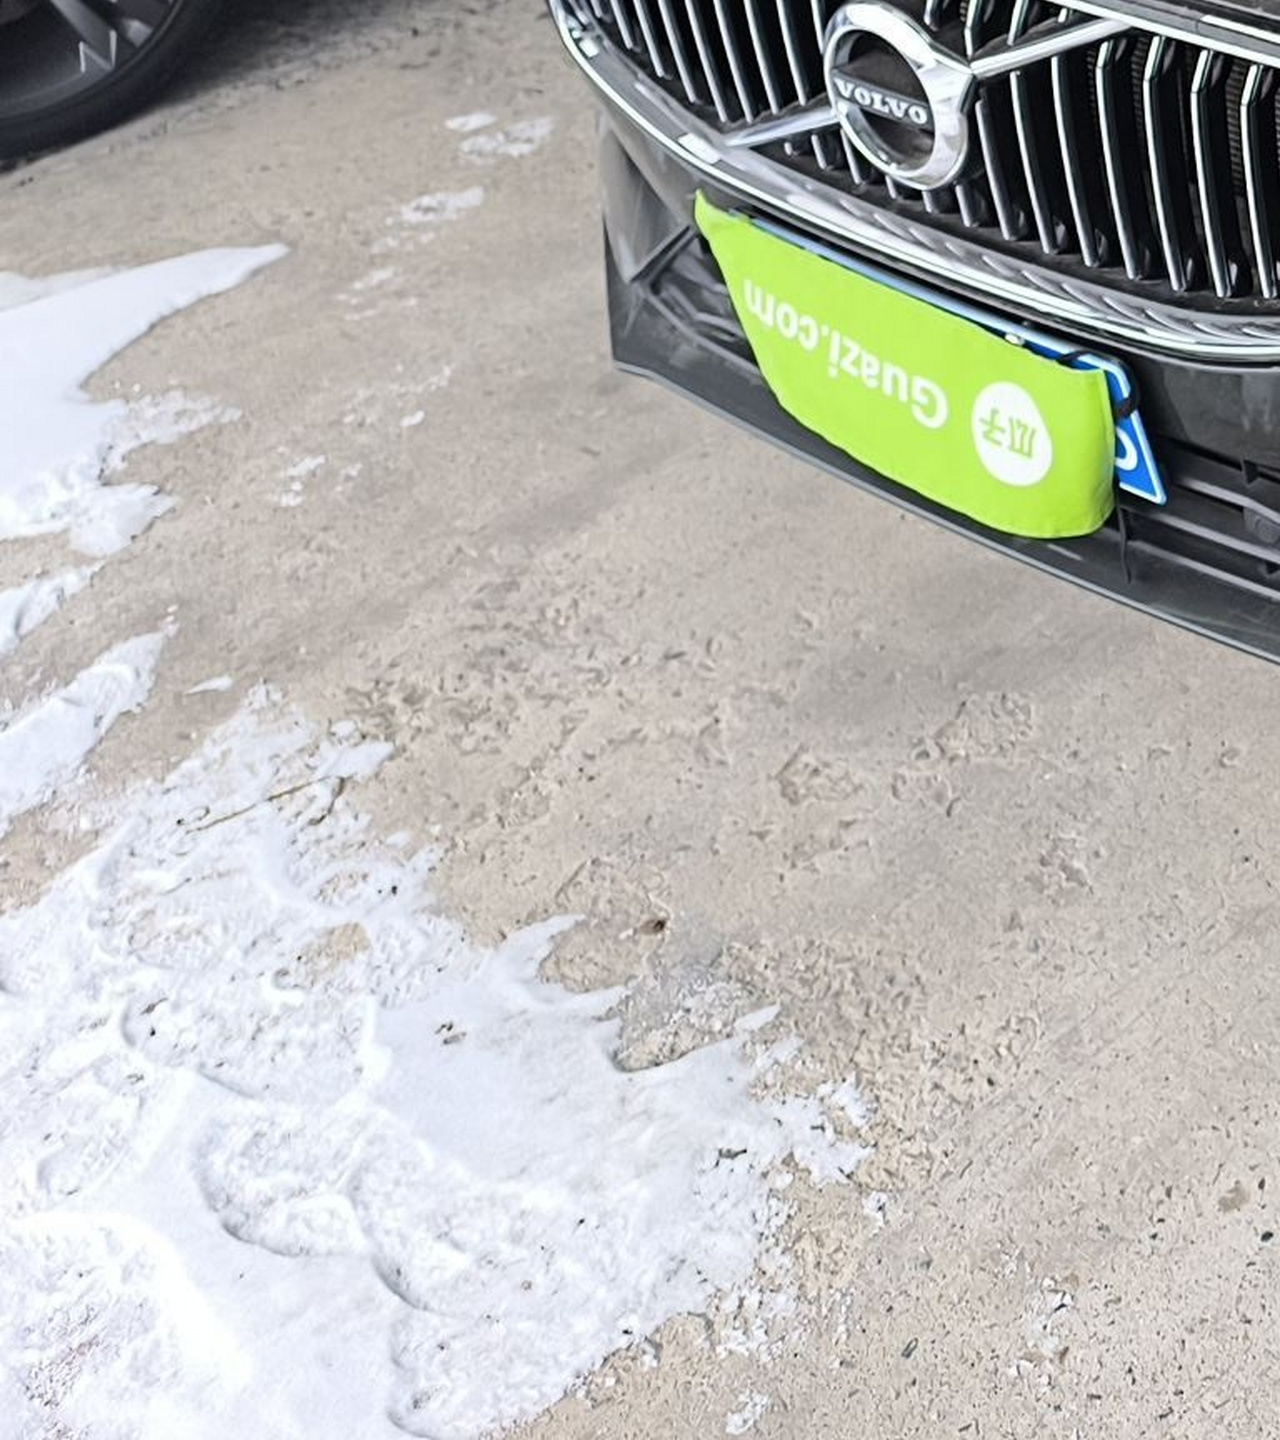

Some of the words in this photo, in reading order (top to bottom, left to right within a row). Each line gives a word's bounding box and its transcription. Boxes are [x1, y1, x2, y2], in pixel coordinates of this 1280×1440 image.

[833, 78, 928, 125] VOLVO
[743, 279, 949, 429] Guazi.com
[978, 406, 1038, 459] 瓜子
